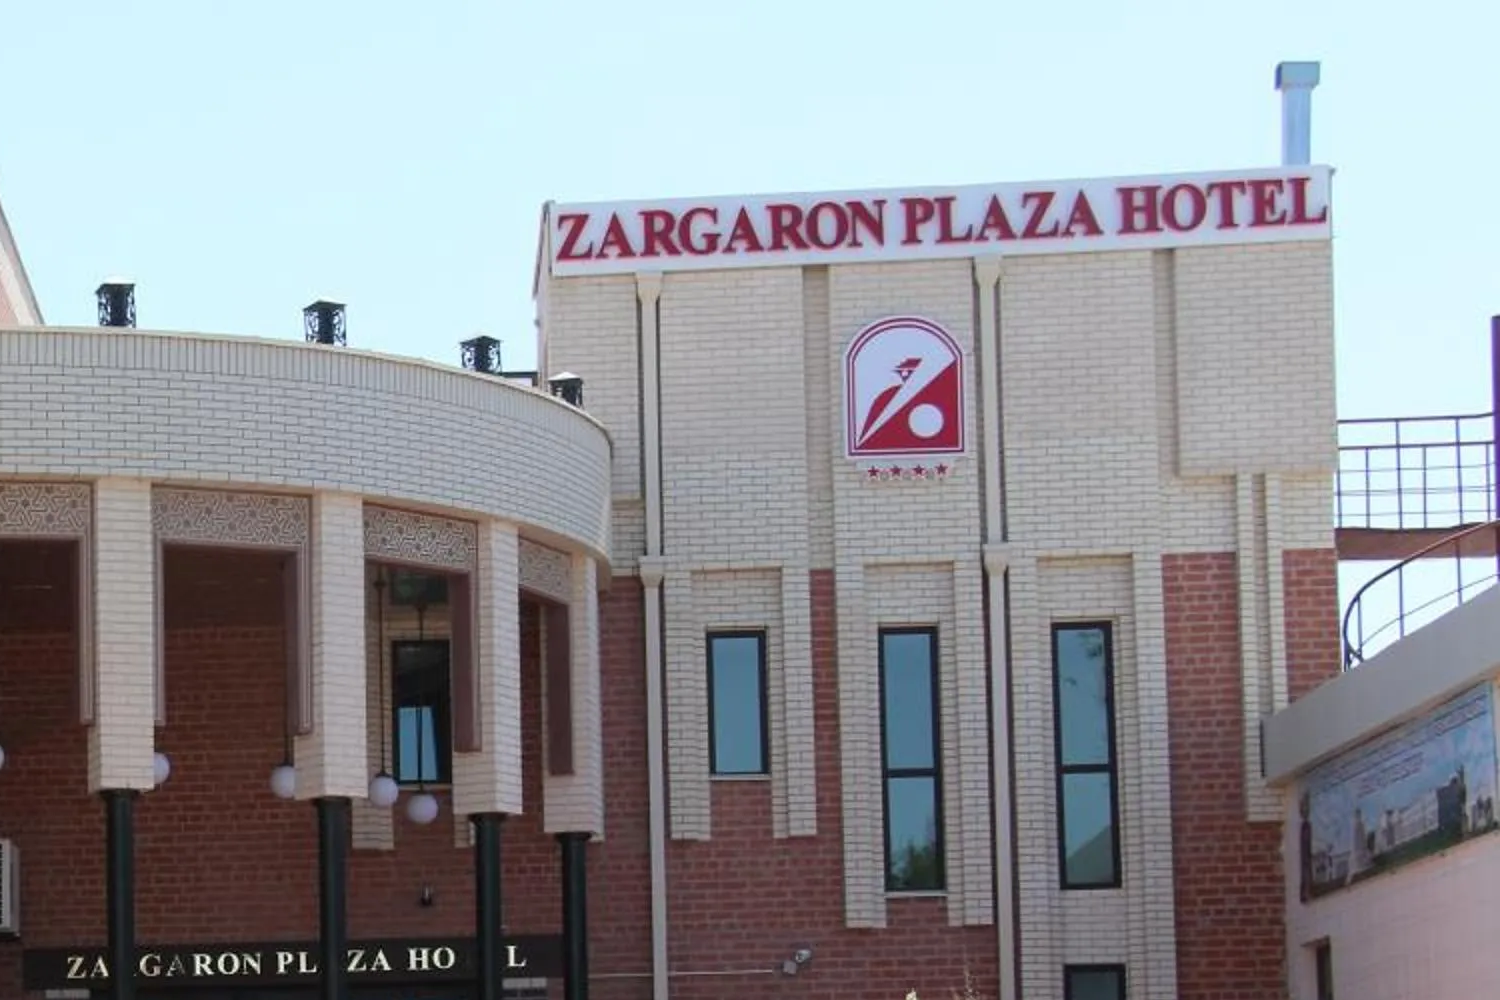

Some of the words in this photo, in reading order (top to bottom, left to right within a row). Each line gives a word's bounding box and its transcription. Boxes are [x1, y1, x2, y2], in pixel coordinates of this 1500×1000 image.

[556, 200, 888, 261] ZARGARON
[901, 190, 1105, 246] PLAZA
[1117, 176, 1329, 235] HOTEL
[66, 952, 263, 980] ZAGARON
[275, 947, 393, 975] PLZA
[406, 945, 528, 971] HOL
